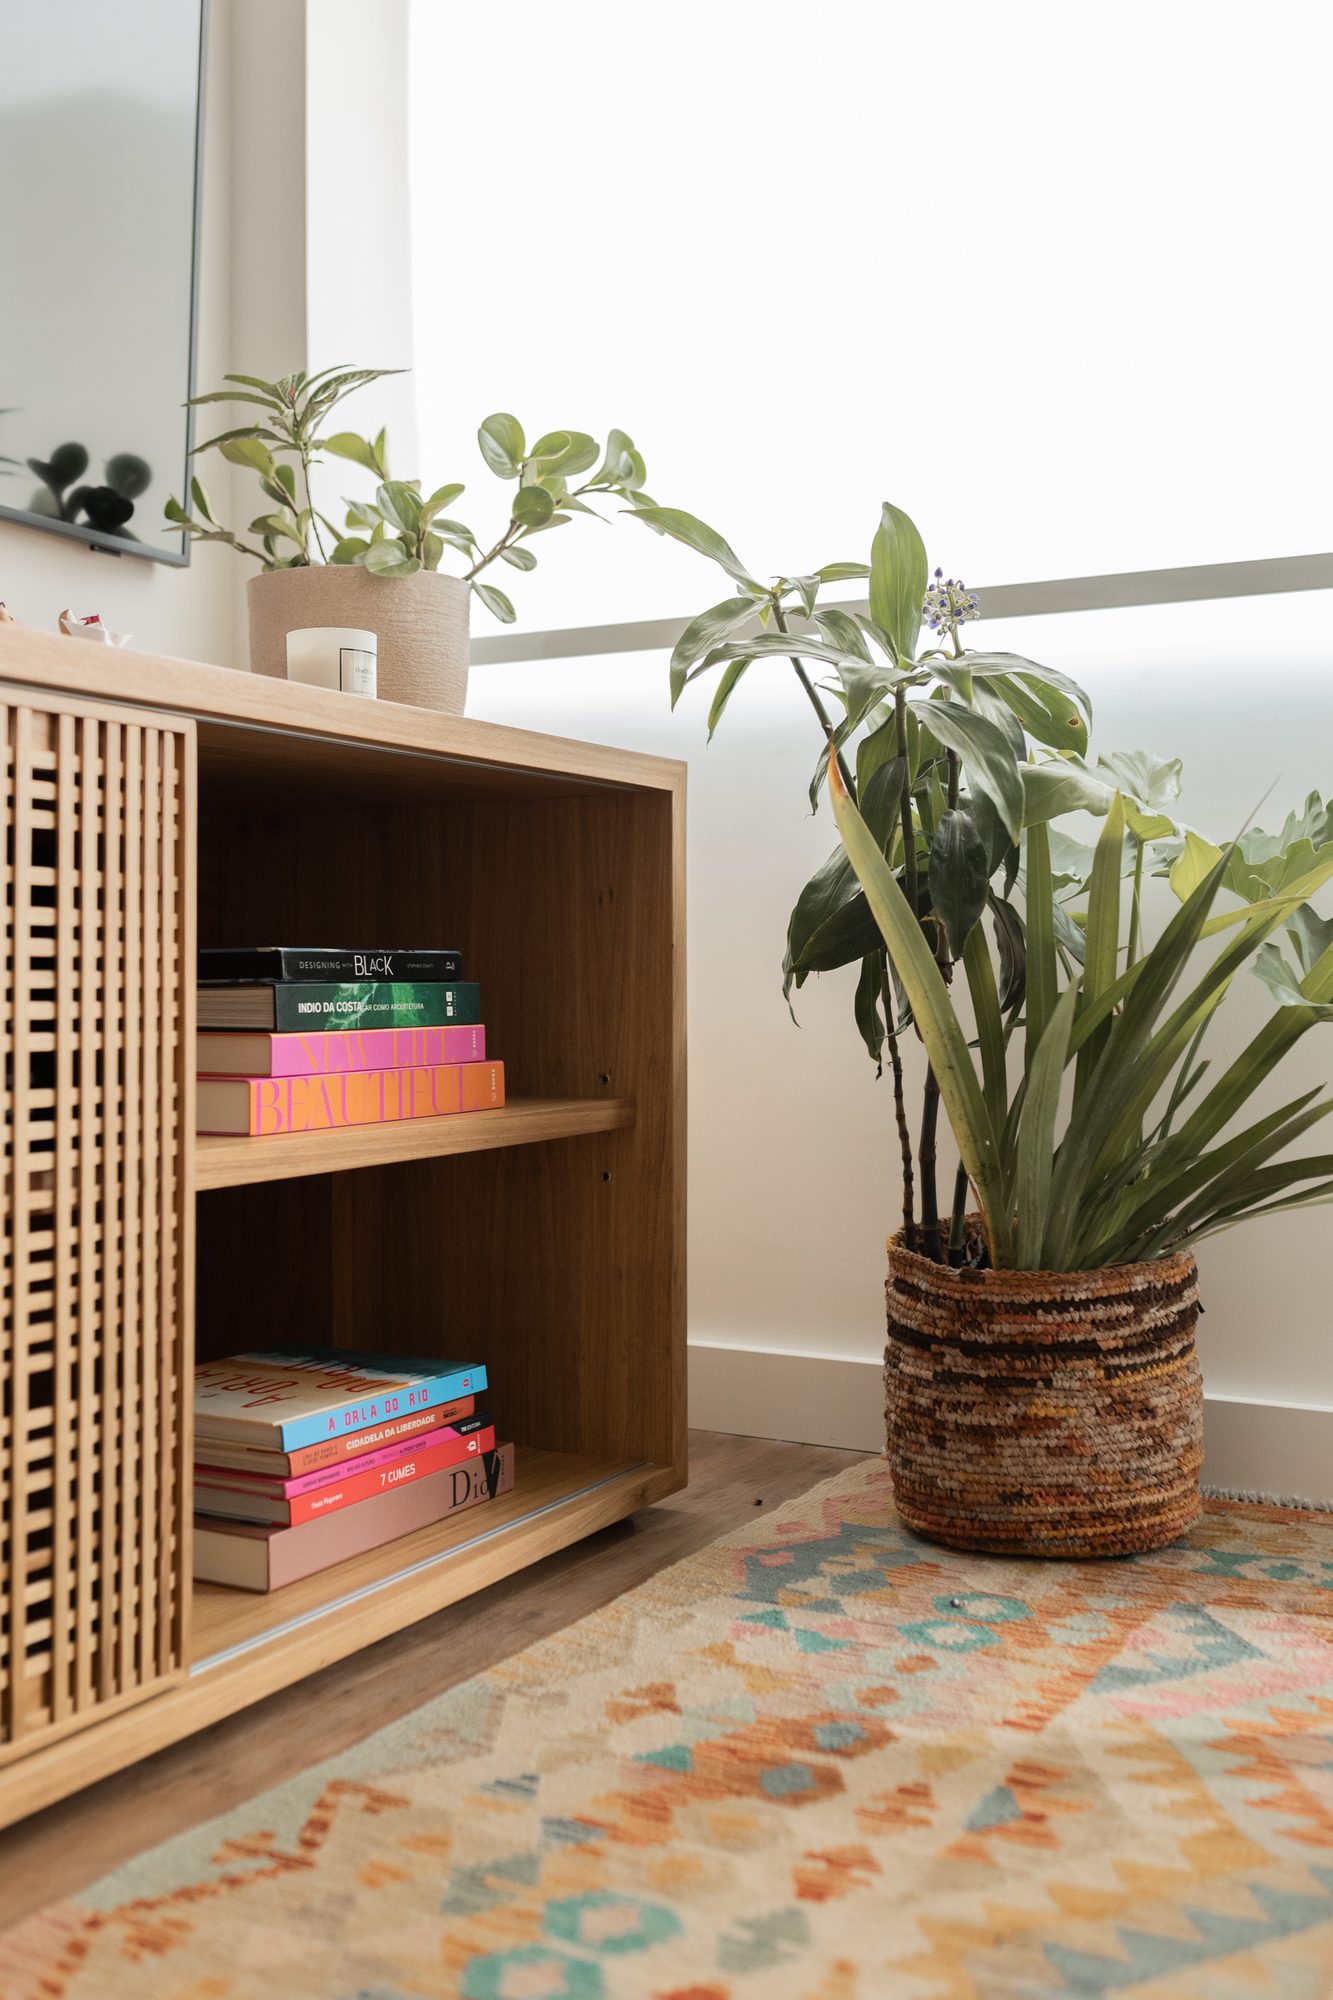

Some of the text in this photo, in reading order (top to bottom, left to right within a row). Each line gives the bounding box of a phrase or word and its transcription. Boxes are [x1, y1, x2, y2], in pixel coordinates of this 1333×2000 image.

[299, 961, 341, 969] DESIGNING
[354, 955, 394, 975] BLACK
[298, 1002, 321, 1013] INDIO
[323, 1002, 335, 1013] DA
[336, 1001, 362, 1012] COSTA
[390, 1026, 458, 1067] LIFE
[255, 1063, 480, 1136] BEAUTIFUL
[329, 1389, 429, 1431] A ORLA DO RIO
[346, 1414, 436, 1450] CIDADELA DA LIBERDADE
[380, 1463, 416, 1487] 7 CUMES
